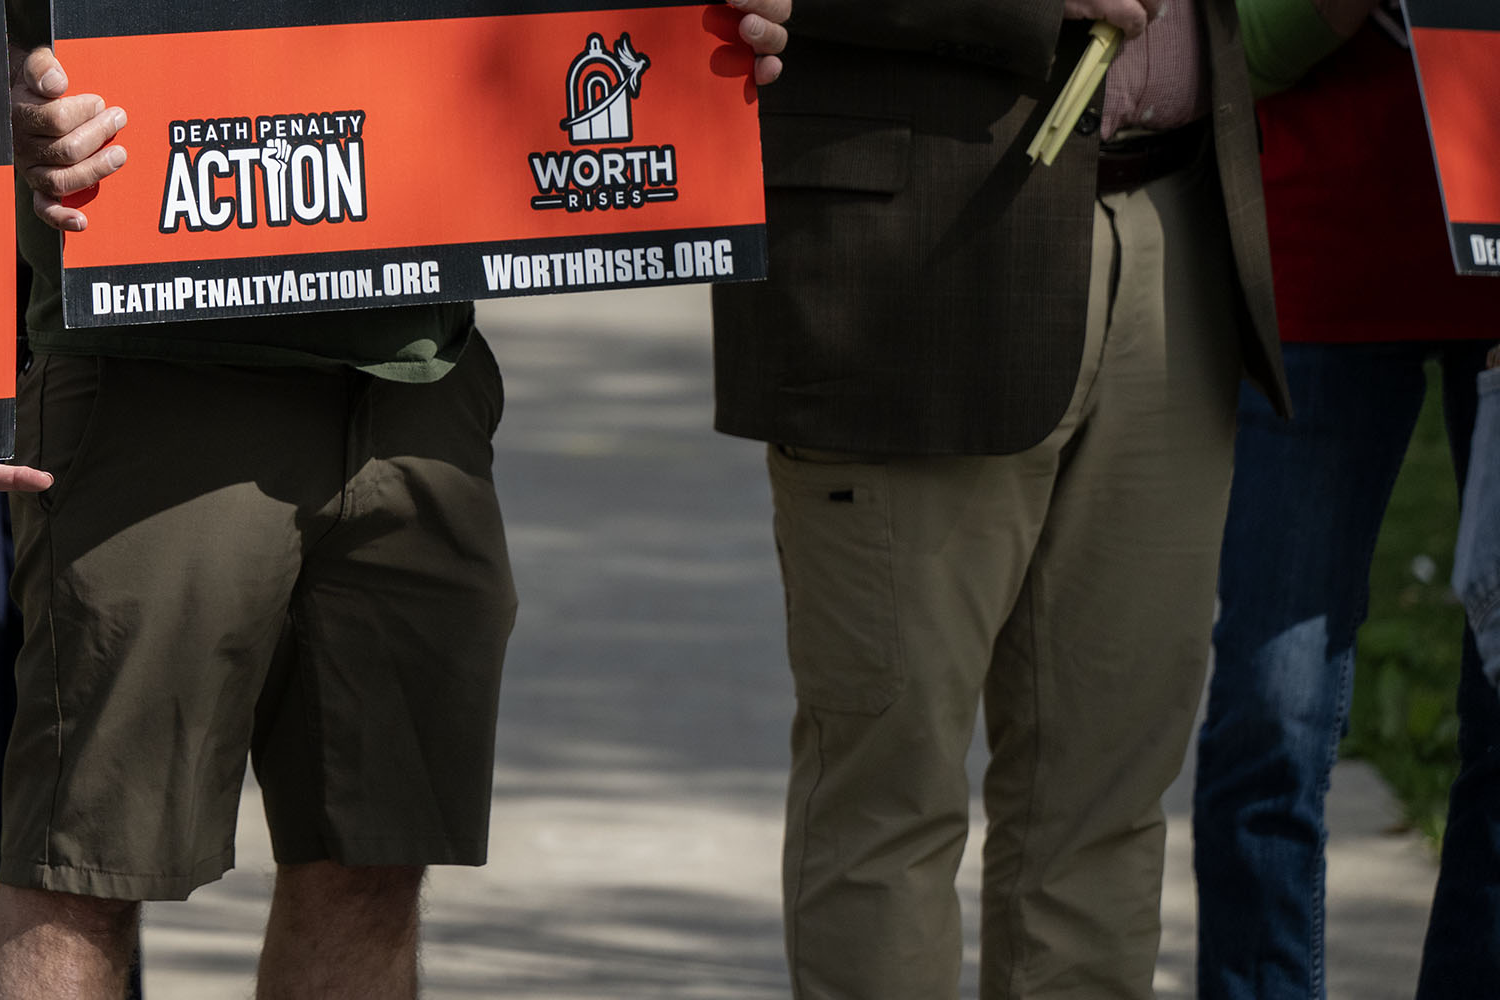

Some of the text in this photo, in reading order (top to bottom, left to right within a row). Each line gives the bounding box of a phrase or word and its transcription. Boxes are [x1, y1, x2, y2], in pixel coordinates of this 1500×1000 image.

[173, 115, 361, 143] DEATH PENALTY
[163, 138, 363, 229] ACTION
[533, 150, 673, 189] WORTH
[568, 190, 641, 207] RISES
